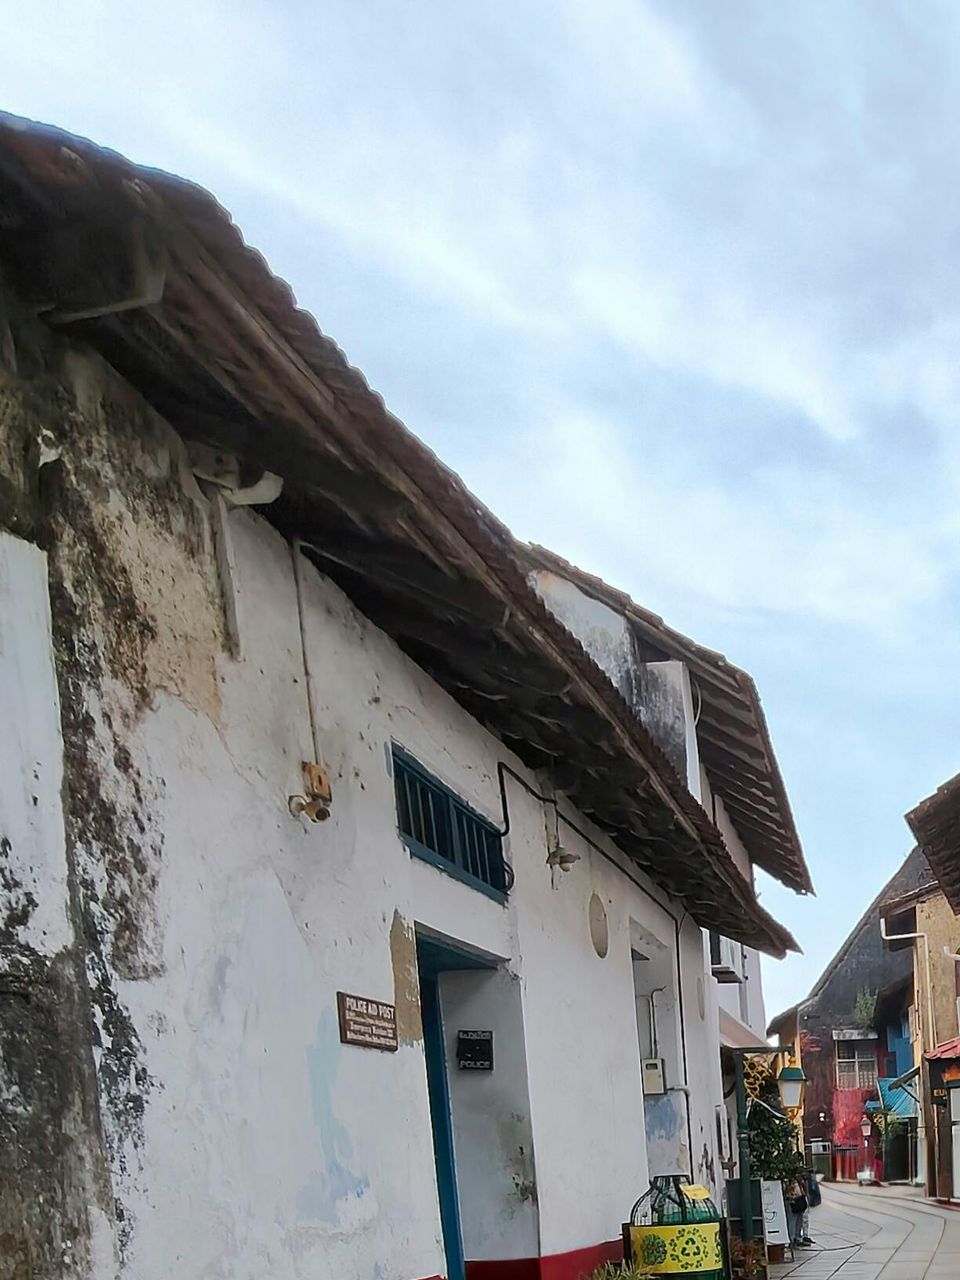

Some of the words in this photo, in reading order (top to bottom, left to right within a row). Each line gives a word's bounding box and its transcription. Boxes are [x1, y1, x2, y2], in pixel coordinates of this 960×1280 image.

[346, 997, 367, 1013] POLICE
[368, 1002, 378, 1016] AID
[379, 1004, 394, 1020] POST
[460, 1060, 491, 1069] POLICE
